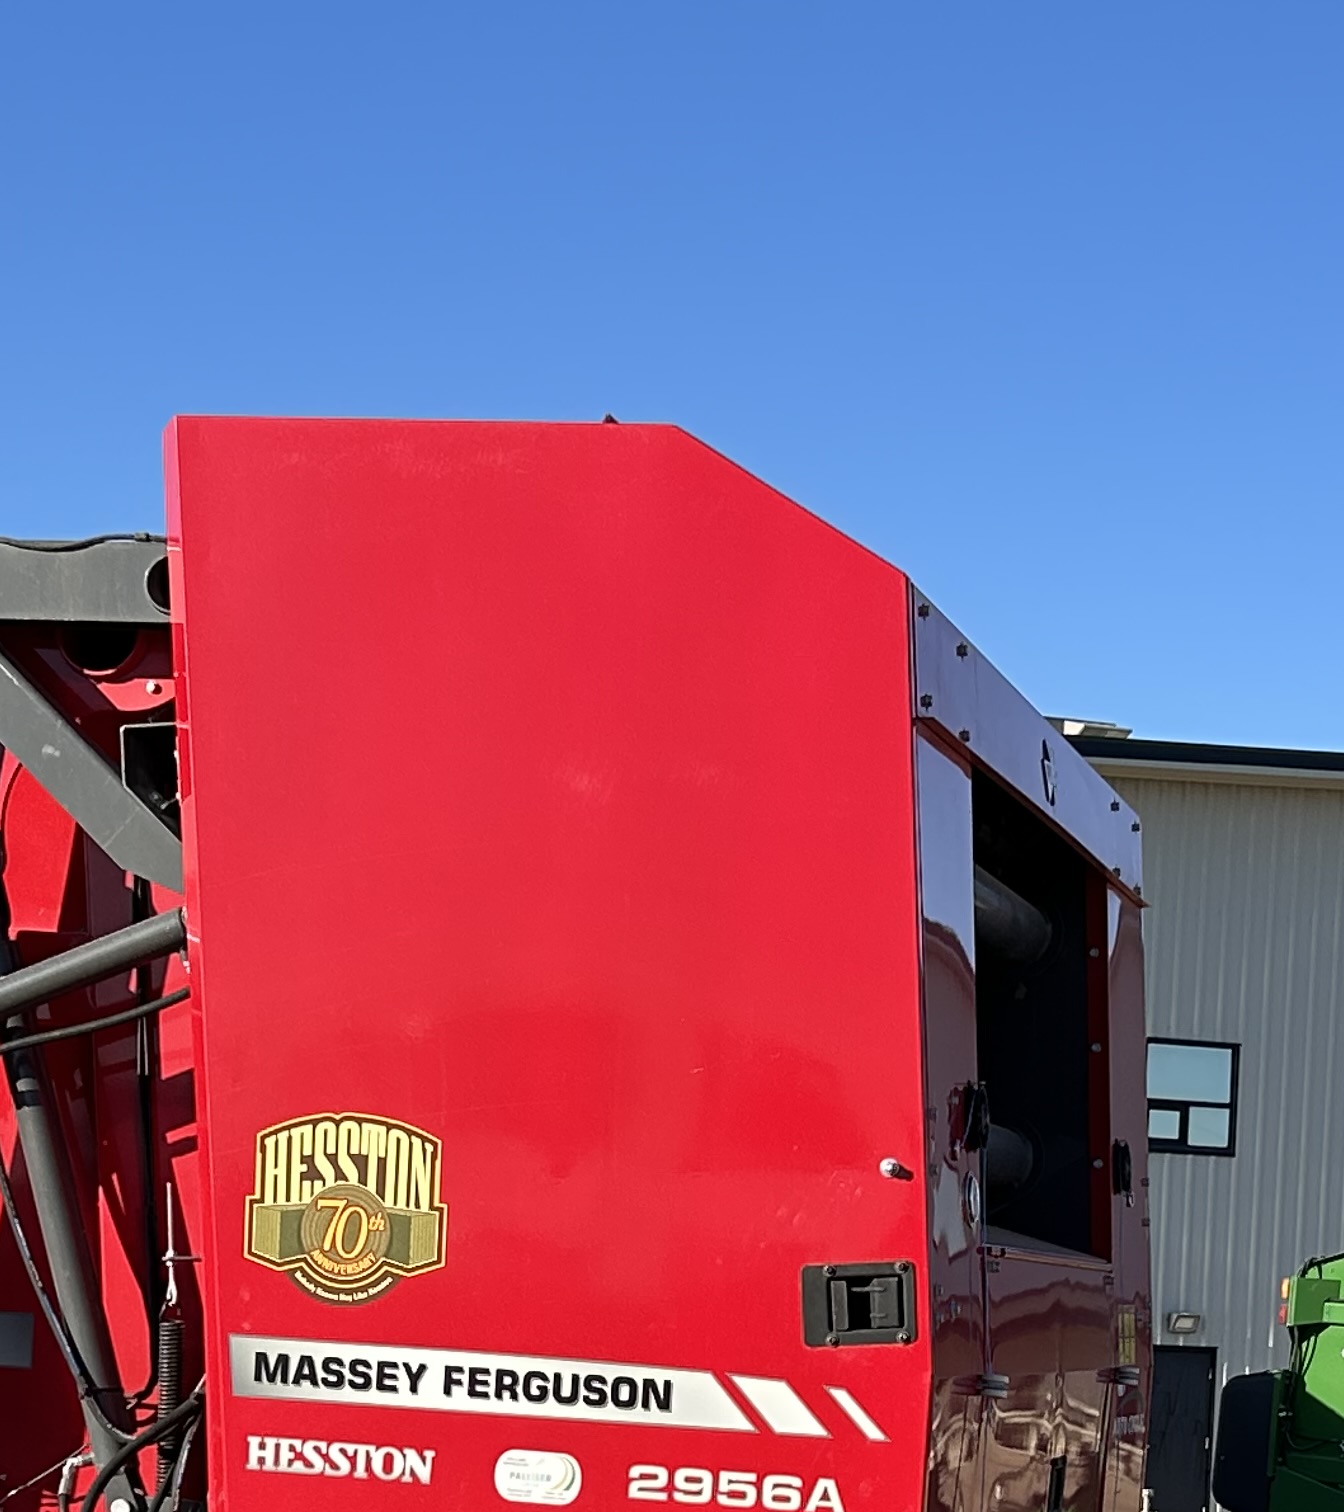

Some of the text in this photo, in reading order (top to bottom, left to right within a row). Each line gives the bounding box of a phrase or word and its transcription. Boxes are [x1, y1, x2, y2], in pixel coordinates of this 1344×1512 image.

[264, 1120, 434, 1212] HESSTON
[316, 1197, 386, 1259] 70th
[309, 1249, 377, 1276] ANNIVERSARY
[253, 1351, 673, 1413] MASSEY FERGUSON
[245, 1435, 436, 1485] HESSTON
